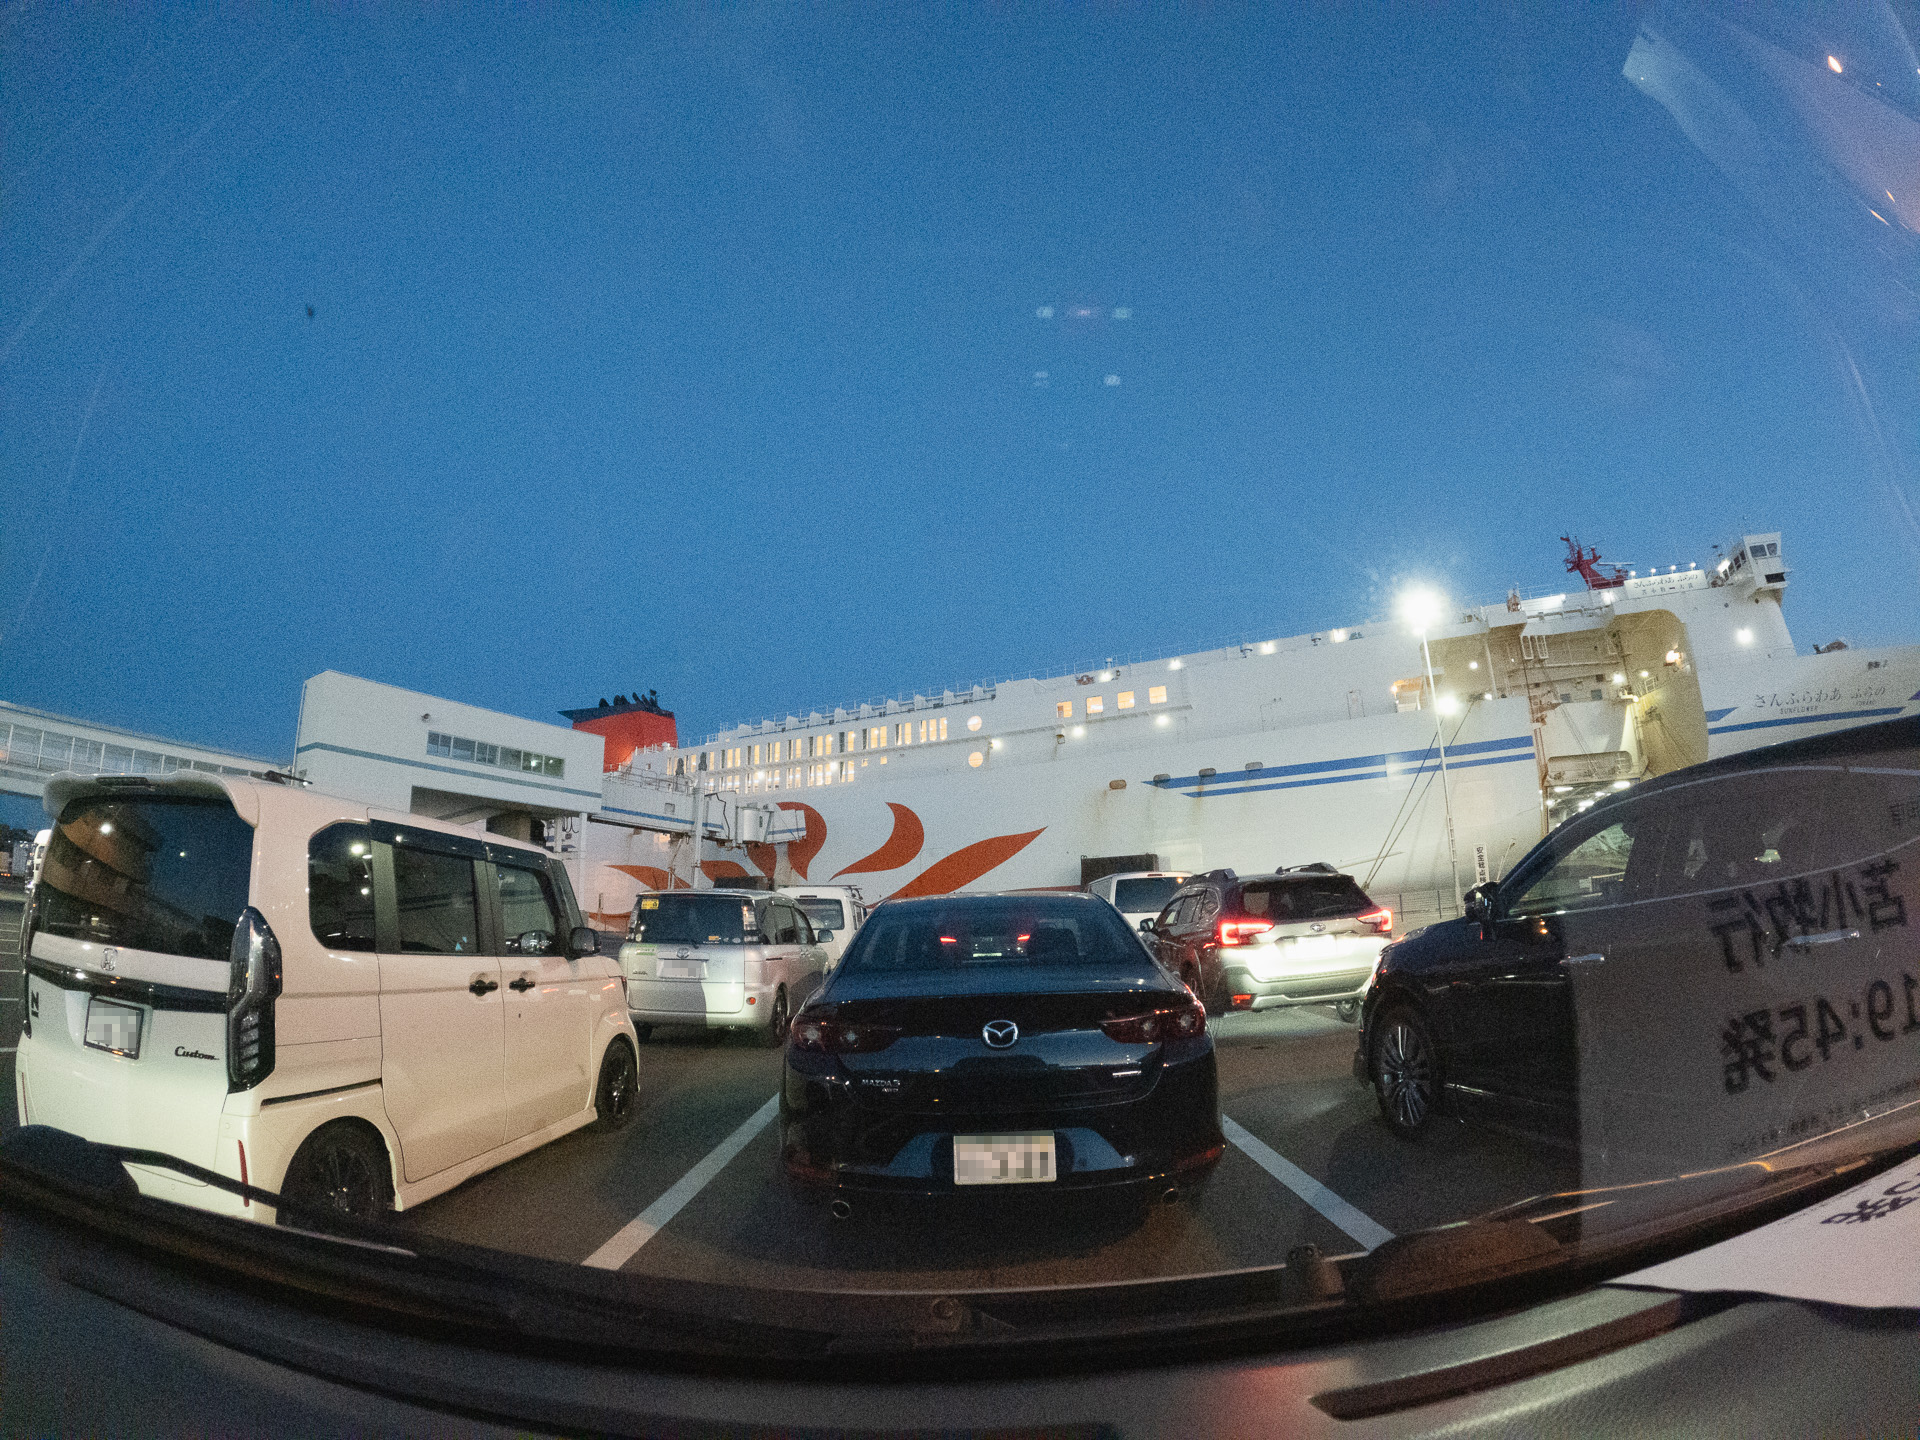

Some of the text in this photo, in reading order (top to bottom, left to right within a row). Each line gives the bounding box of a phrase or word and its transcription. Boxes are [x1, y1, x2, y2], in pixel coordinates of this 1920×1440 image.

[1754, 688, 1841, 708] さんふらわあ
[174, 1045, 220, 1061] Custom
